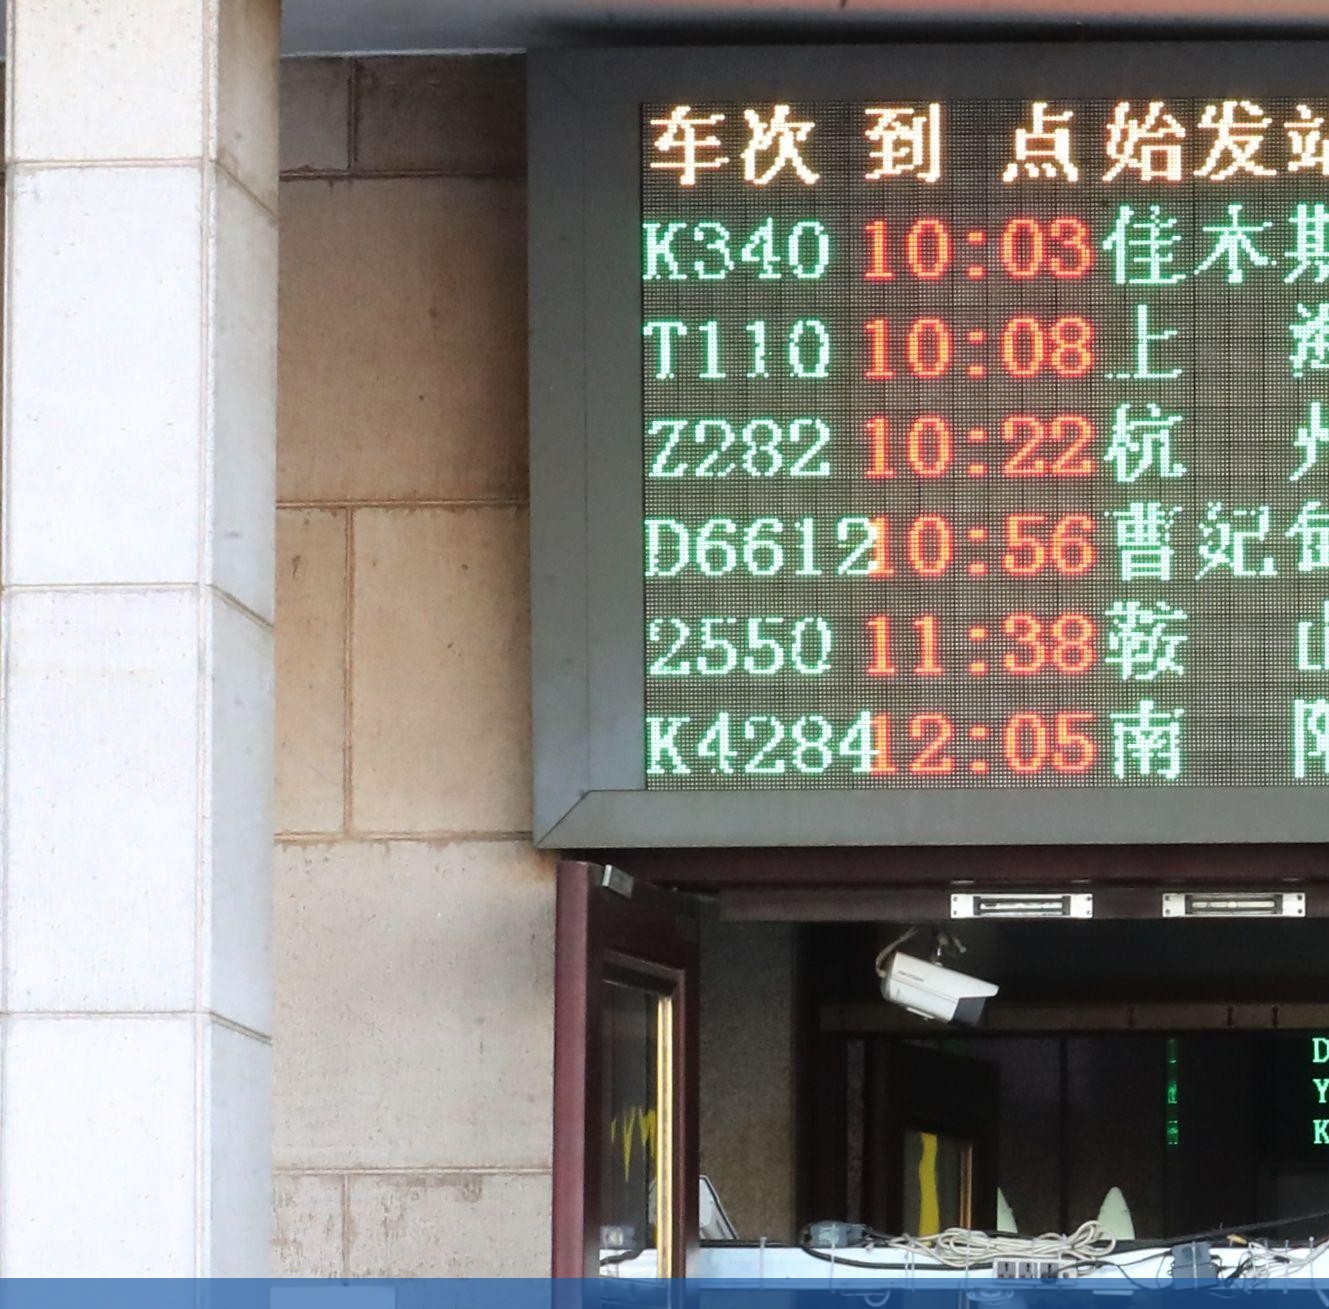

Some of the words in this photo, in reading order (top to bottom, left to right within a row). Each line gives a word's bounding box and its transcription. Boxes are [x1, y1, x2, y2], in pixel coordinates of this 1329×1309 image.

[652, 107, 820, 186] 车次
[643, 219, 829, 281] K340
[867, 218, 1095, 281] 10:03
[645, 321, 830, 379] T110
[867, 316, 1095, 380] 10:08
[650, 419, 830, 478] Z282
[869, 415, 1096, 479] 10:22
[646, 518, 879, 577] D6612
[868, 514, 1096, 578] 10:56
[651, 619, 832, 676] 2550
[869, 613, 1097, 677] 11:38
[648, 712, 880, 776] K4284
[871, 713, 1097, 776] 12:05
